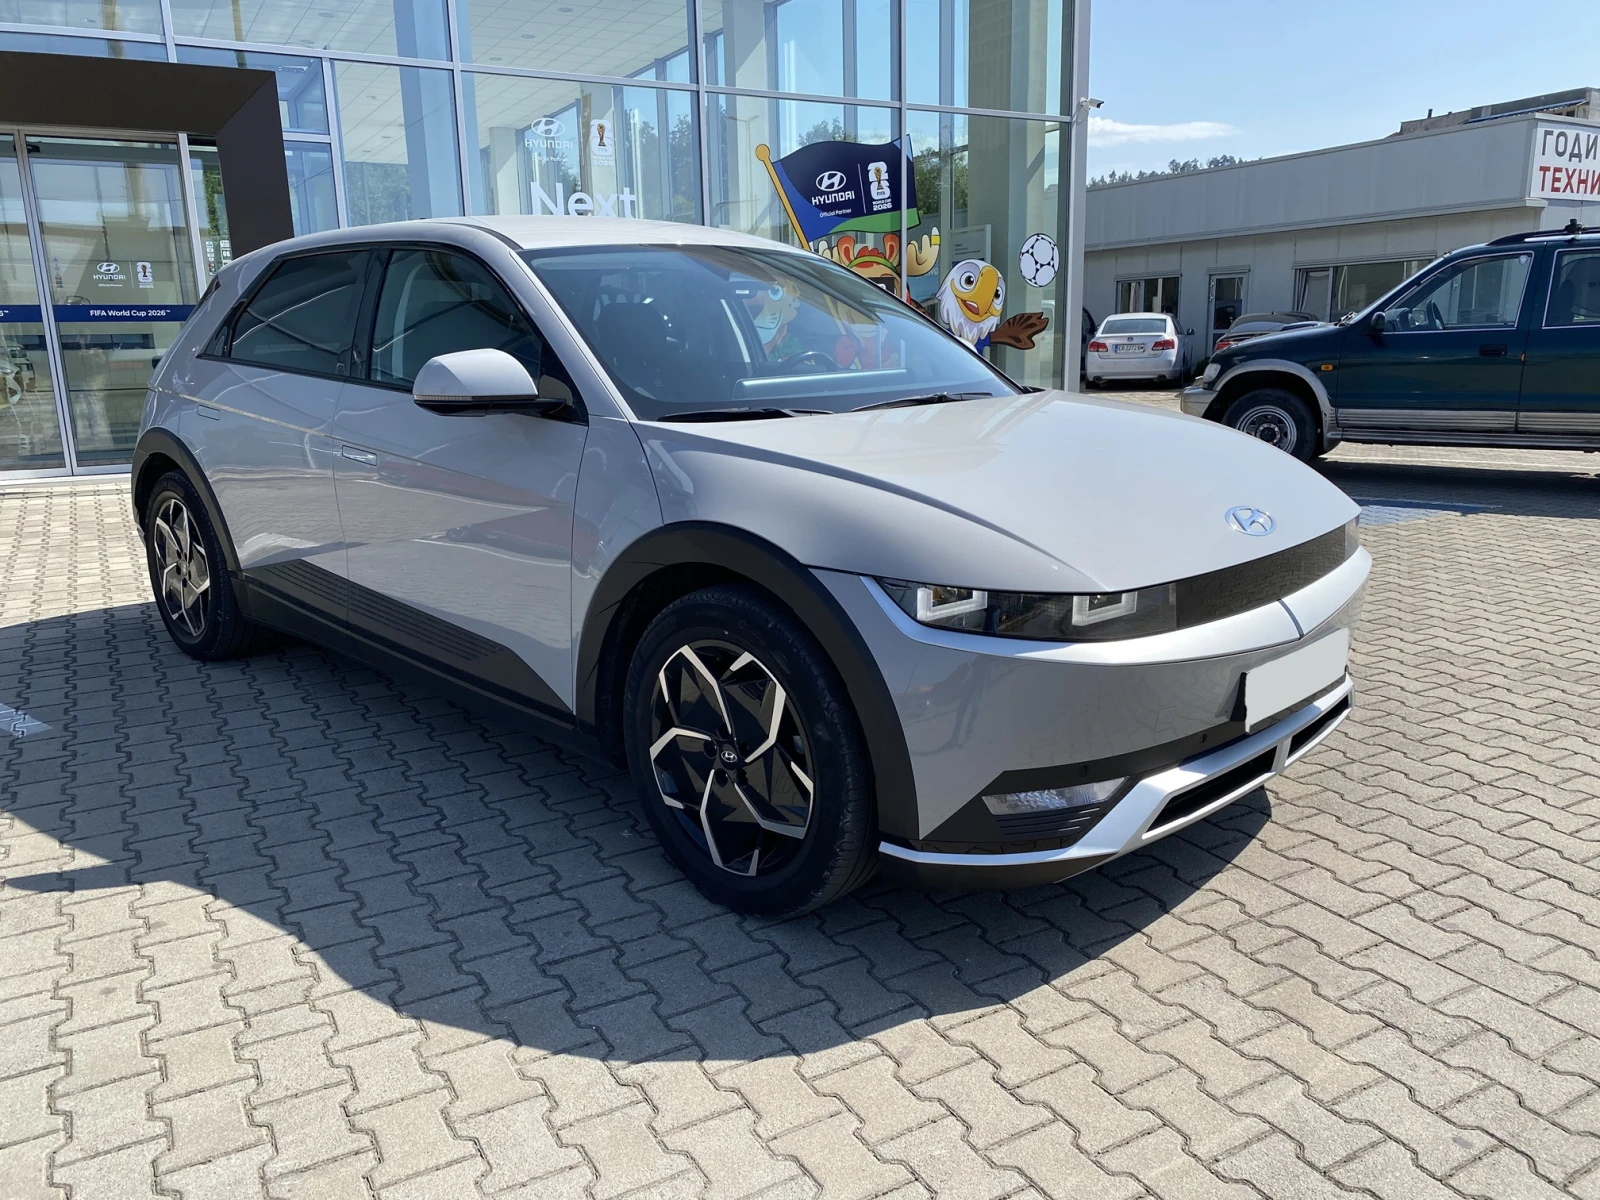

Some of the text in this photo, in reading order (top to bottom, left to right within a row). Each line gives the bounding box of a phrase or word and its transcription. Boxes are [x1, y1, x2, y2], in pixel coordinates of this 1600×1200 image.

[525, 139, 573, 149] HYUNDAI
[1541, 129, 1598, 163] ГОДИ
[530, 181, 636, 218] Next
[811, 190, 855, 206] HYUNDAI
[872, 202, 893, 211] 2026
[835, 208, 852, 216] Partner
[90, 309, 107, 317] FIFA
[107, 309, 130, 317] World
[131, 309, 147, 318] Cup
